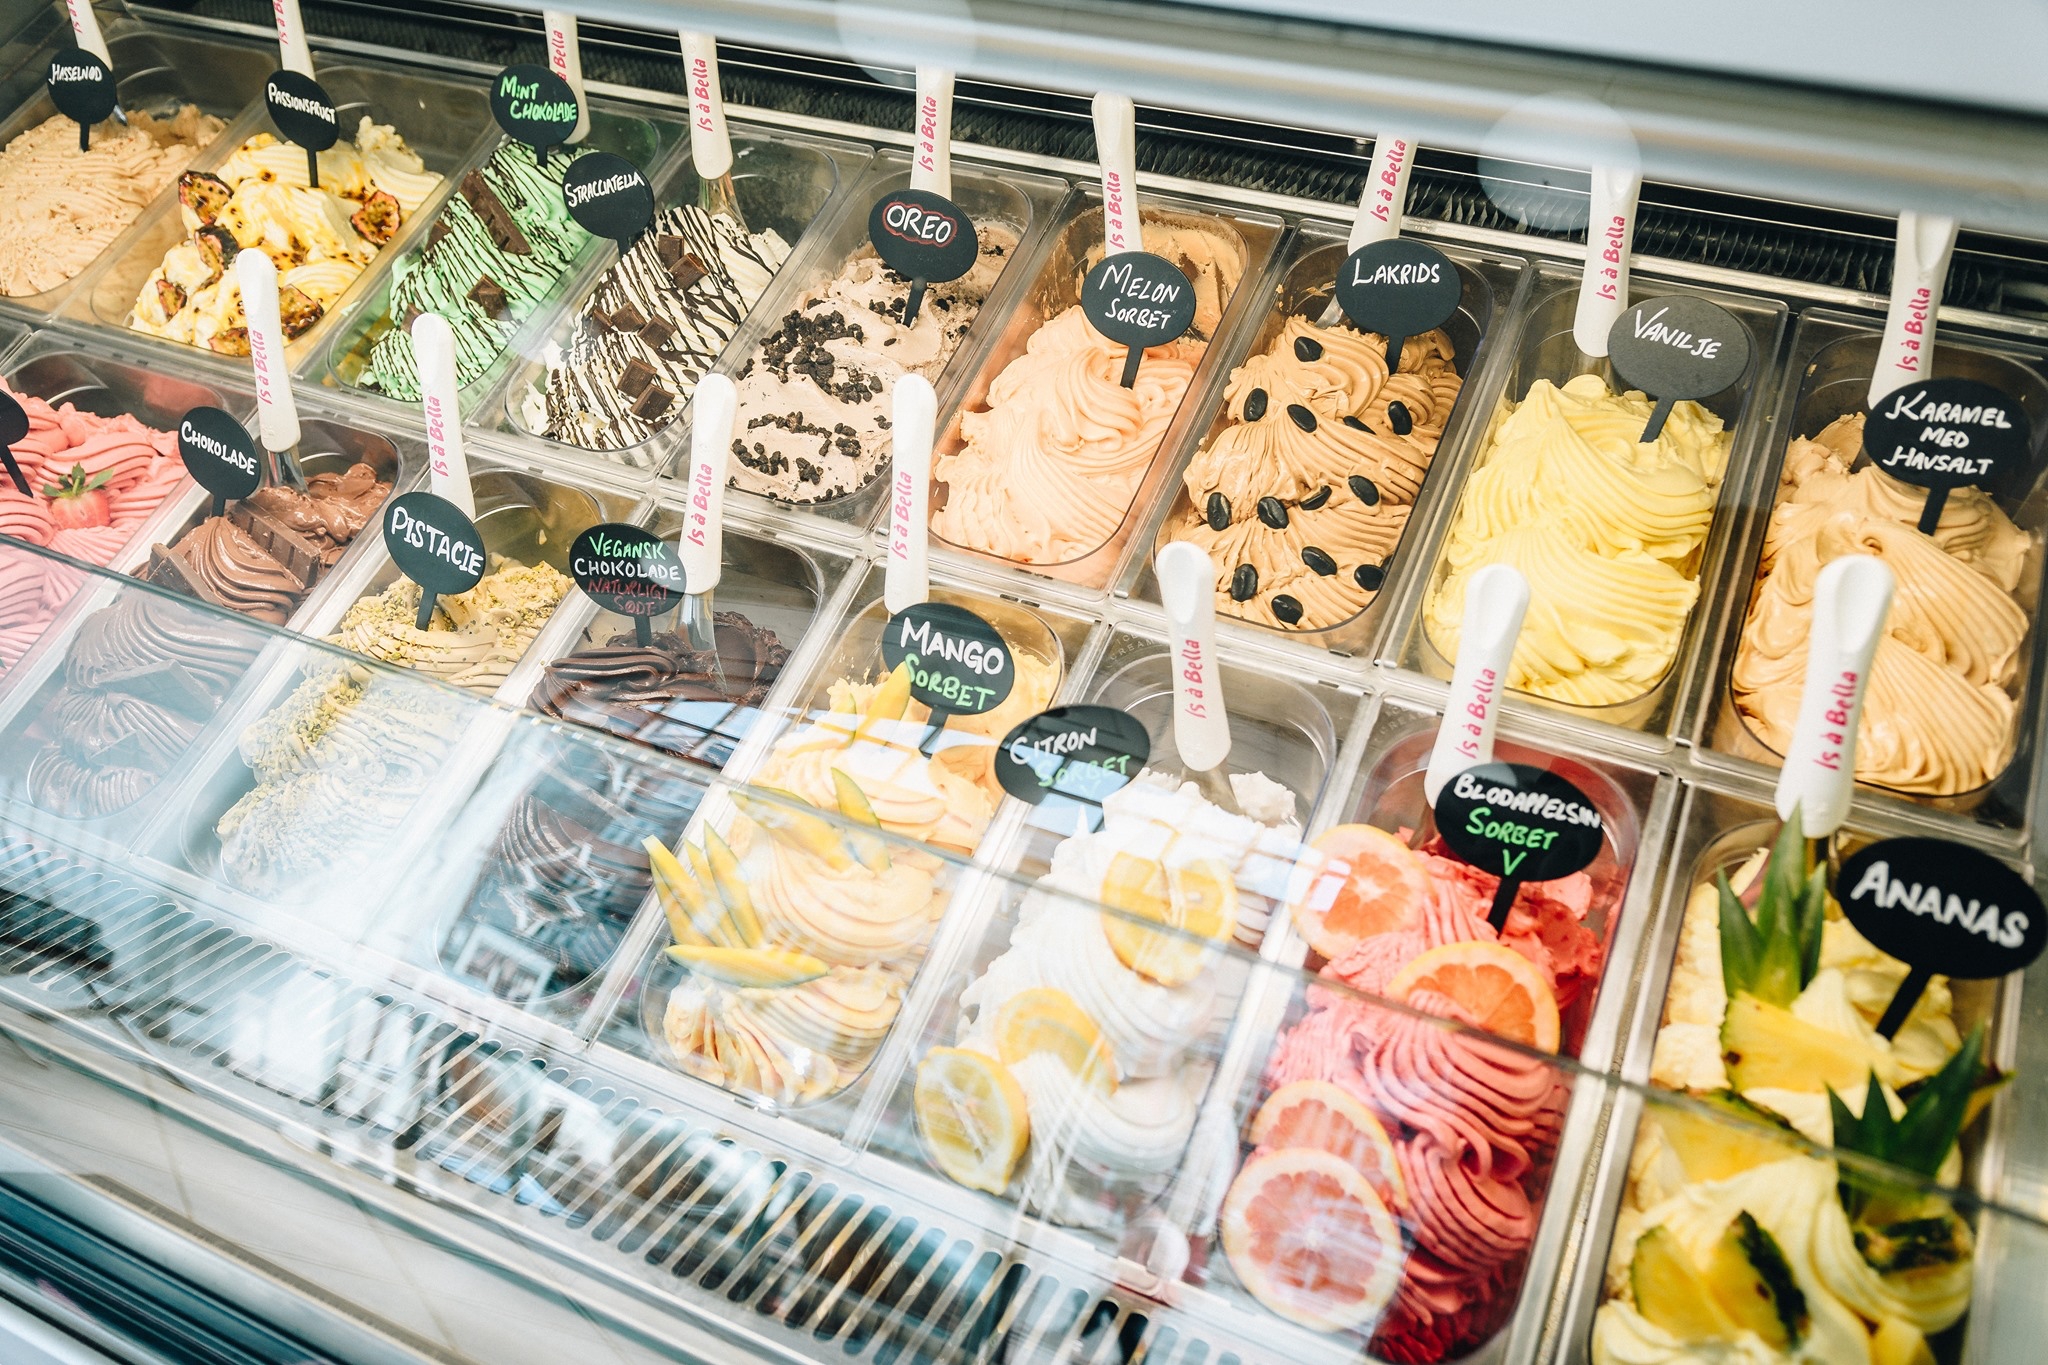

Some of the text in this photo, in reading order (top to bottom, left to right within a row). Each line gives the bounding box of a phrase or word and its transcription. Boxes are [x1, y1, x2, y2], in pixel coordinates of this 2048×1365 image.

[551, 30, 567, 69] Bella
[692, 58, 710, 100] Bella
[268, 82, 336, 125] PASSIONSFRUGT
[510, 99, 578, 122] CHOKOLADE
[921, 96, 937, 140] Bella
[696, 117, 713, 132] Is
[918, 155, 934, 172] Is
[1370, 204, 1389, 222] Is
[1381, 139, 1406, 187] Bella
[564, 172, 644, 208] STRACCIATELLA
[1106, 171, 1122, 215] Bella
[886, 204, 952, 243] OREO
[1109, 233, 1125, 249] Is
[1602, 215, 1625, 263] Bella
[1099, 263, 1180, 304] MELON
[1352, 258, 1440, 287] LAKRIDS
[1595, 284, 1617, 300] Is
[1105, 298, 1172, 330] SORBET
[1903, 287, 1931, 335] Bella
[252, 329, 268, 373] Bella
[1634, 307, 1722, 359] VANILJE
[1895, 355, 1918, 371] Is
[257, 388, 273, 405] Is
[1885, 390, 2012, 430] KARAMEL
[426, 395, 444, 442] Bella
[1919, 427, 1970, 449] MED
[181, 420, 258, 476] CHOKOLADE
[1882, 446, 1994, 476] HAVSALT
[432, 459, 449, 477] Is
[692, 463, 712, 511] Bella
[894, 471, 912, 522] Bella
[390, 506, 485, 576] PISTACIE
[588, 532, 666, 560] VEGANSK
[687, 528, 705, 547] Is
[890, 540, 908, 560] Is
[574, 558, 682, 581] CHOKOLADE
[900, 616, 1005, 675] MANGO
[1181, 639, 1203, 684] Bella
[905, 653, 996, 710] SORBET
[1466, 668, 1497, 720] Bella
[1825, 671, 1858, 726] Bella
[1184, 702, 1207, 719] Is
[1010, 727, 1097, 765] CITRON
[1454, 740, 1479, 759] Is
[1812, 750, 1842, 771] Is
[1034, 754, 1131, 787] SORBET
[1465, 806, 1560, 850] SORBET
[1502, 849, 1528, 876] V
[1850, 860, 2030, 949] ANANAS
